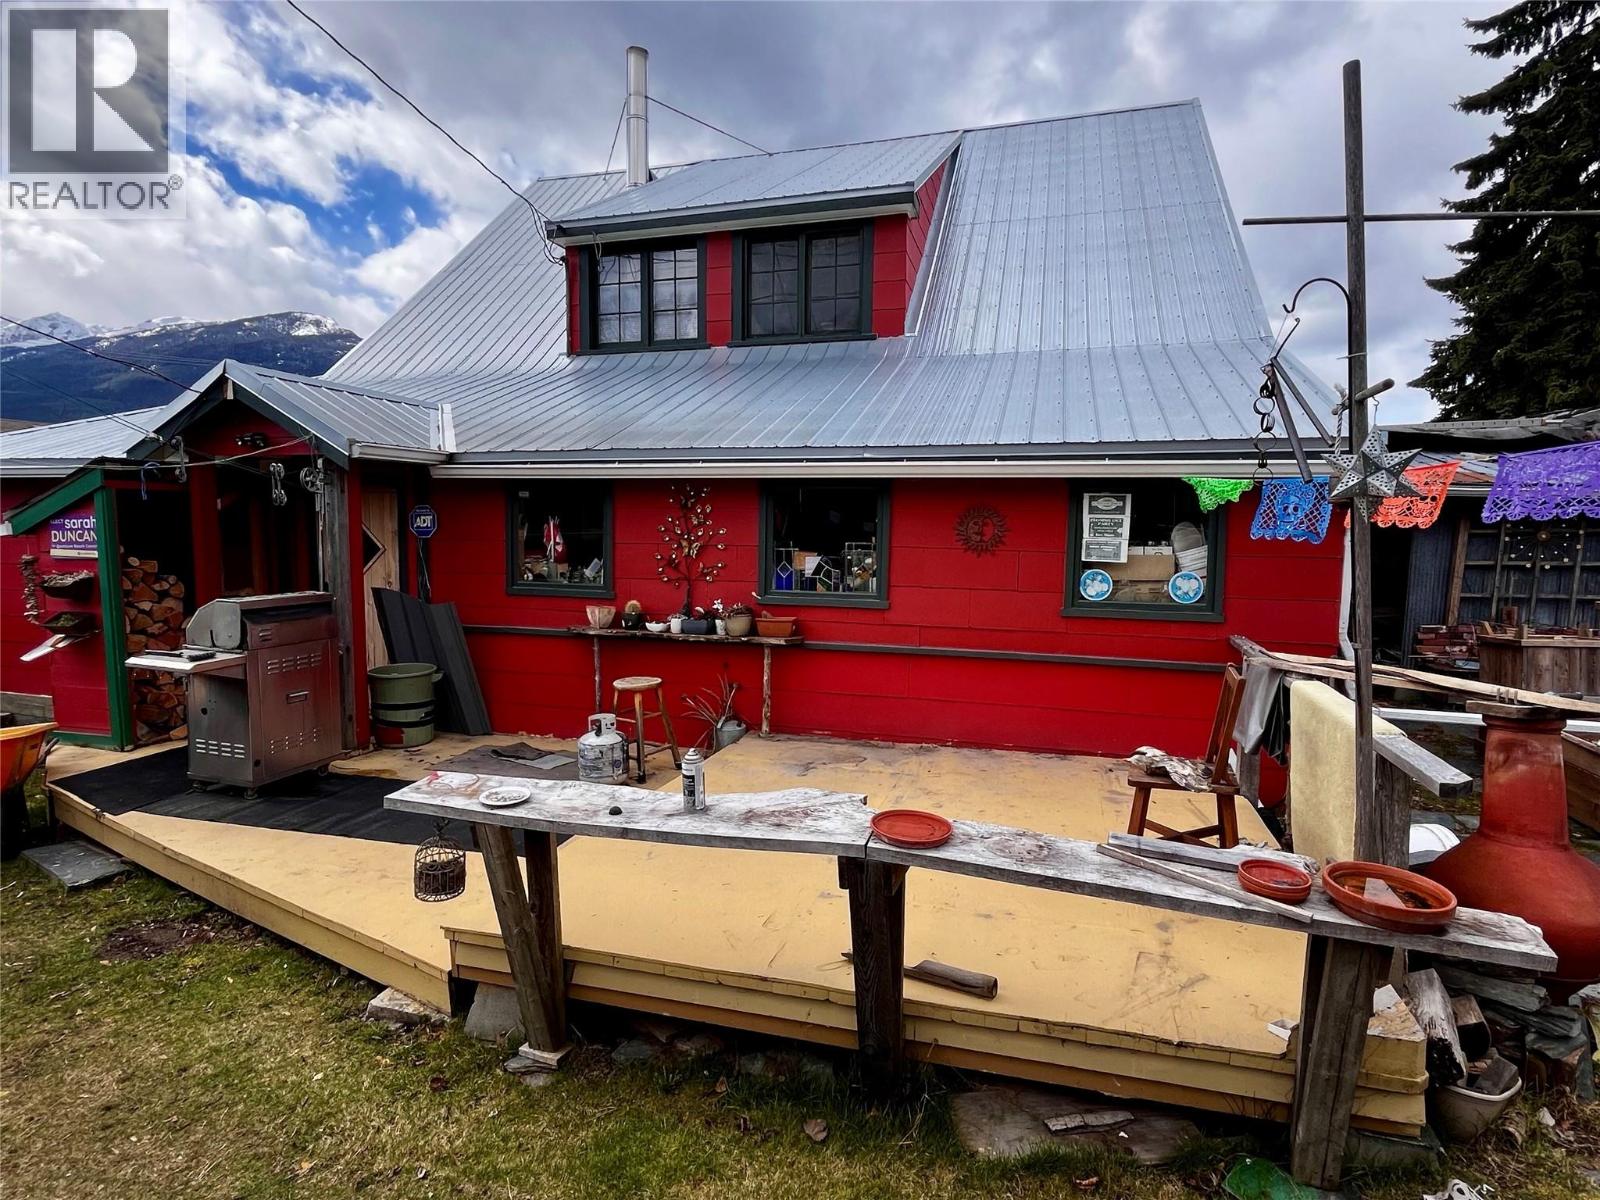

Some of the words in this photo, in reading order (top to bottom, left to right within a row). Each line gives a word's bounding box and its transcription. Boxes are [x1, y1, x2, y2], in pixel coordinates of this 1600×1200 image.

[65, 515, 97, 529] sarah
[414, 515, 432, 527] ADT
[51, 530, 97, 542] DUNCAN
